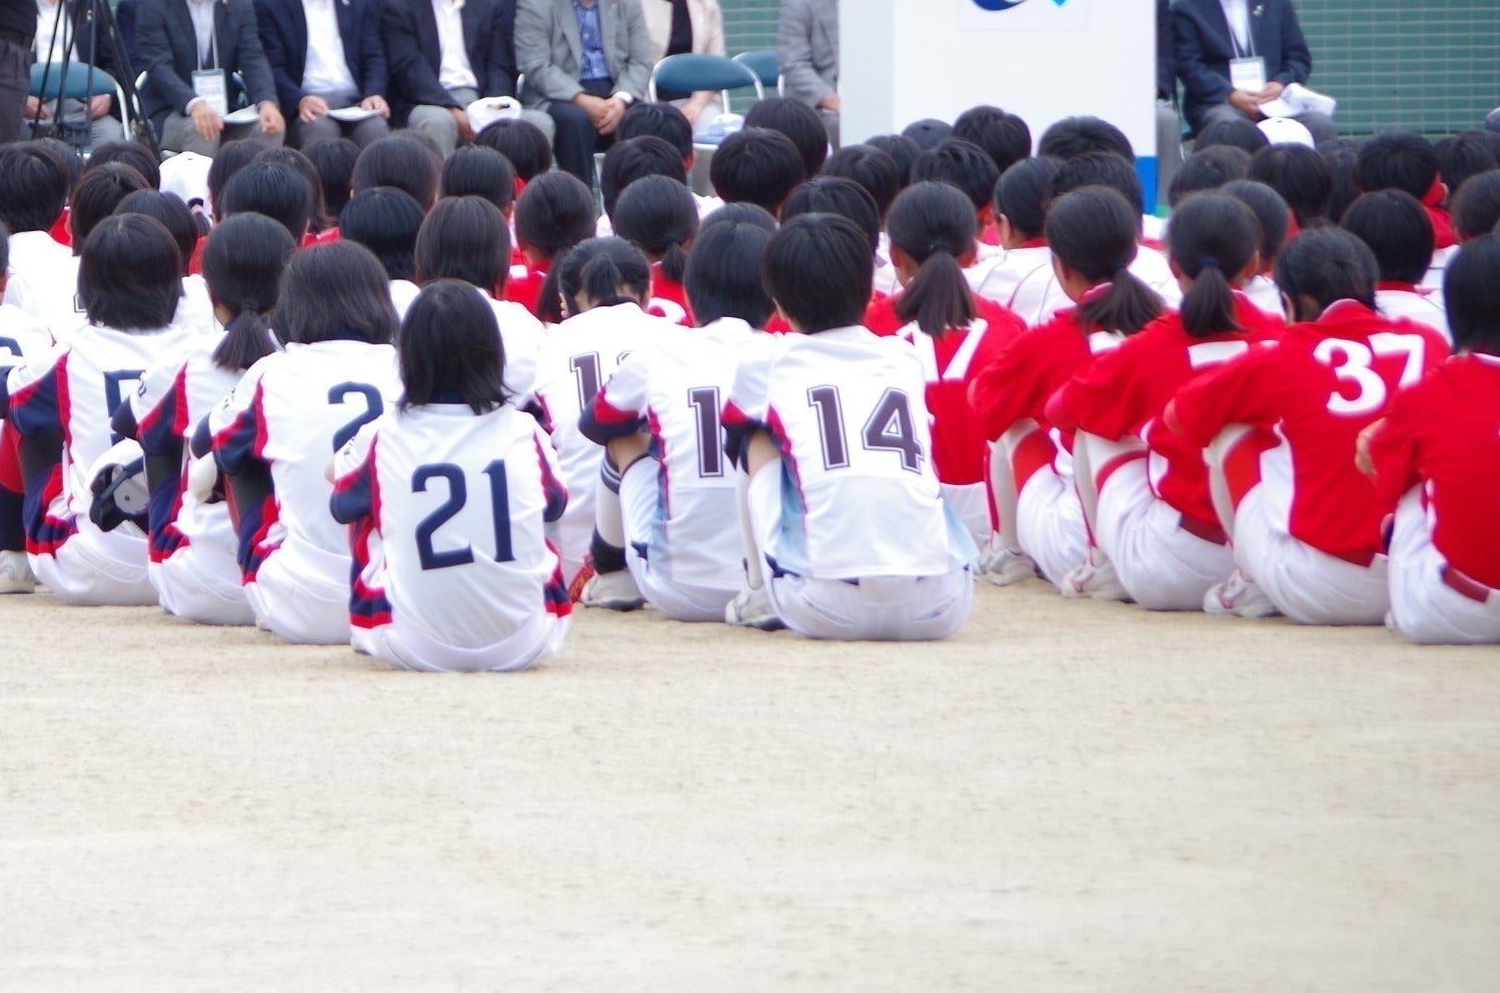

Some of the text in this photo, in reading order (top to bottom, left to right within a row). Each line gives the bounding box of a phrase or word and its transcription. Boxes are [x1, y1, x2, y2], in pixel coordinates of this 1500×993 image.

[1312, 332, 1426, 417] 37
[806, 384, 926, 475] 14
[411, 459, 516, 571] 21
